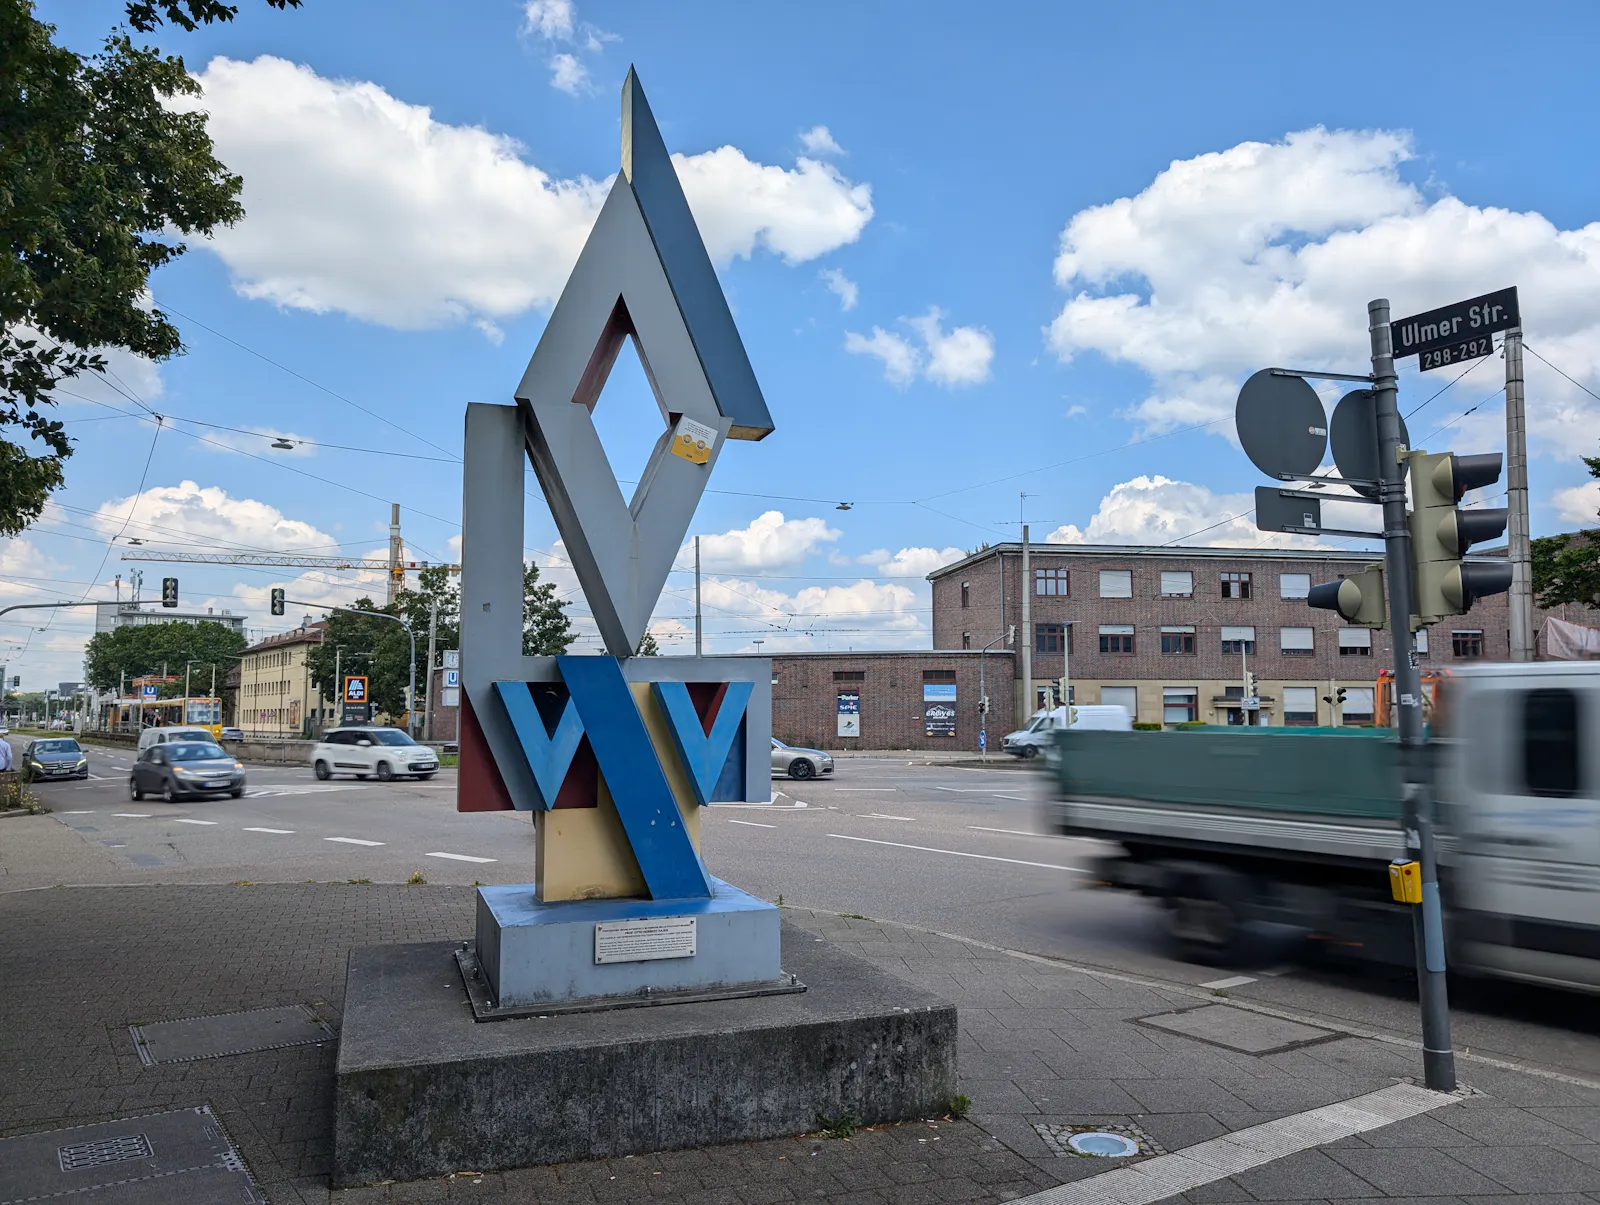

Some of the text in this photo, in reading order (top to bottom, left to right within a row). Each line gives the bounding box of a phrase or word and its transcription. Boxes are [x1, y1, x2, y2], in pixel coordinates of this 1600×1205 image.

[1401, 302, 1508, 347] Ulmer Str.
[1424, 338, 1488, 369] 298-292
[450, 672, 457, 683] U
